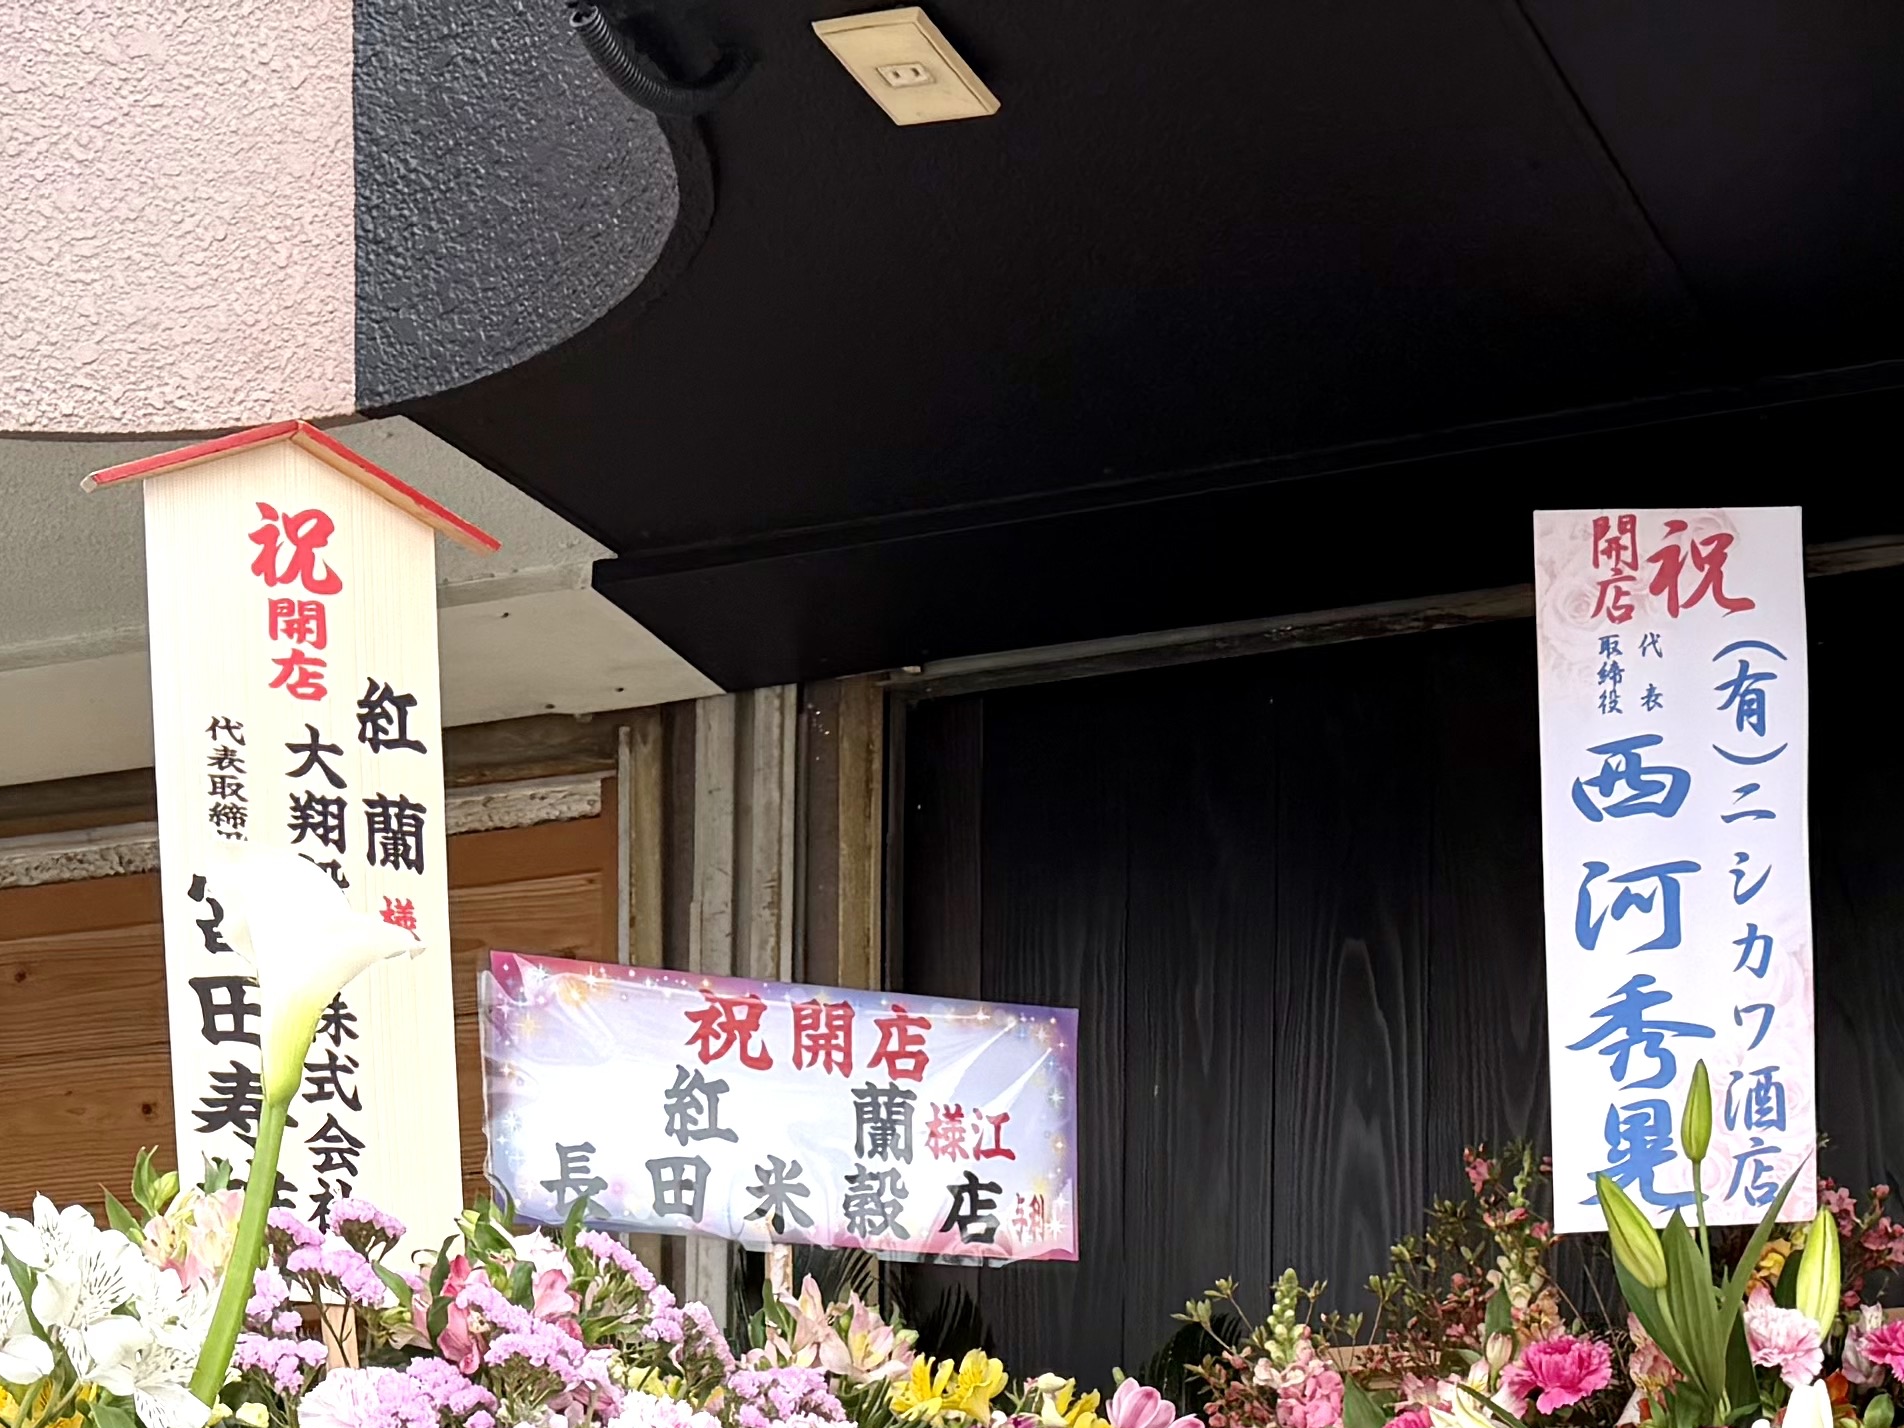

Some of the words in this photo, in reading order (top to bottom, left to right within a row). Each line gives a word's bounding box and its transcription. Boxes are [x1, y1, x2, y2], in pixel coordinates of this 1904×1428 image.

[205, 715, 249, 842] 代表取締
[685, 988, 933, 1083] 祝開店
